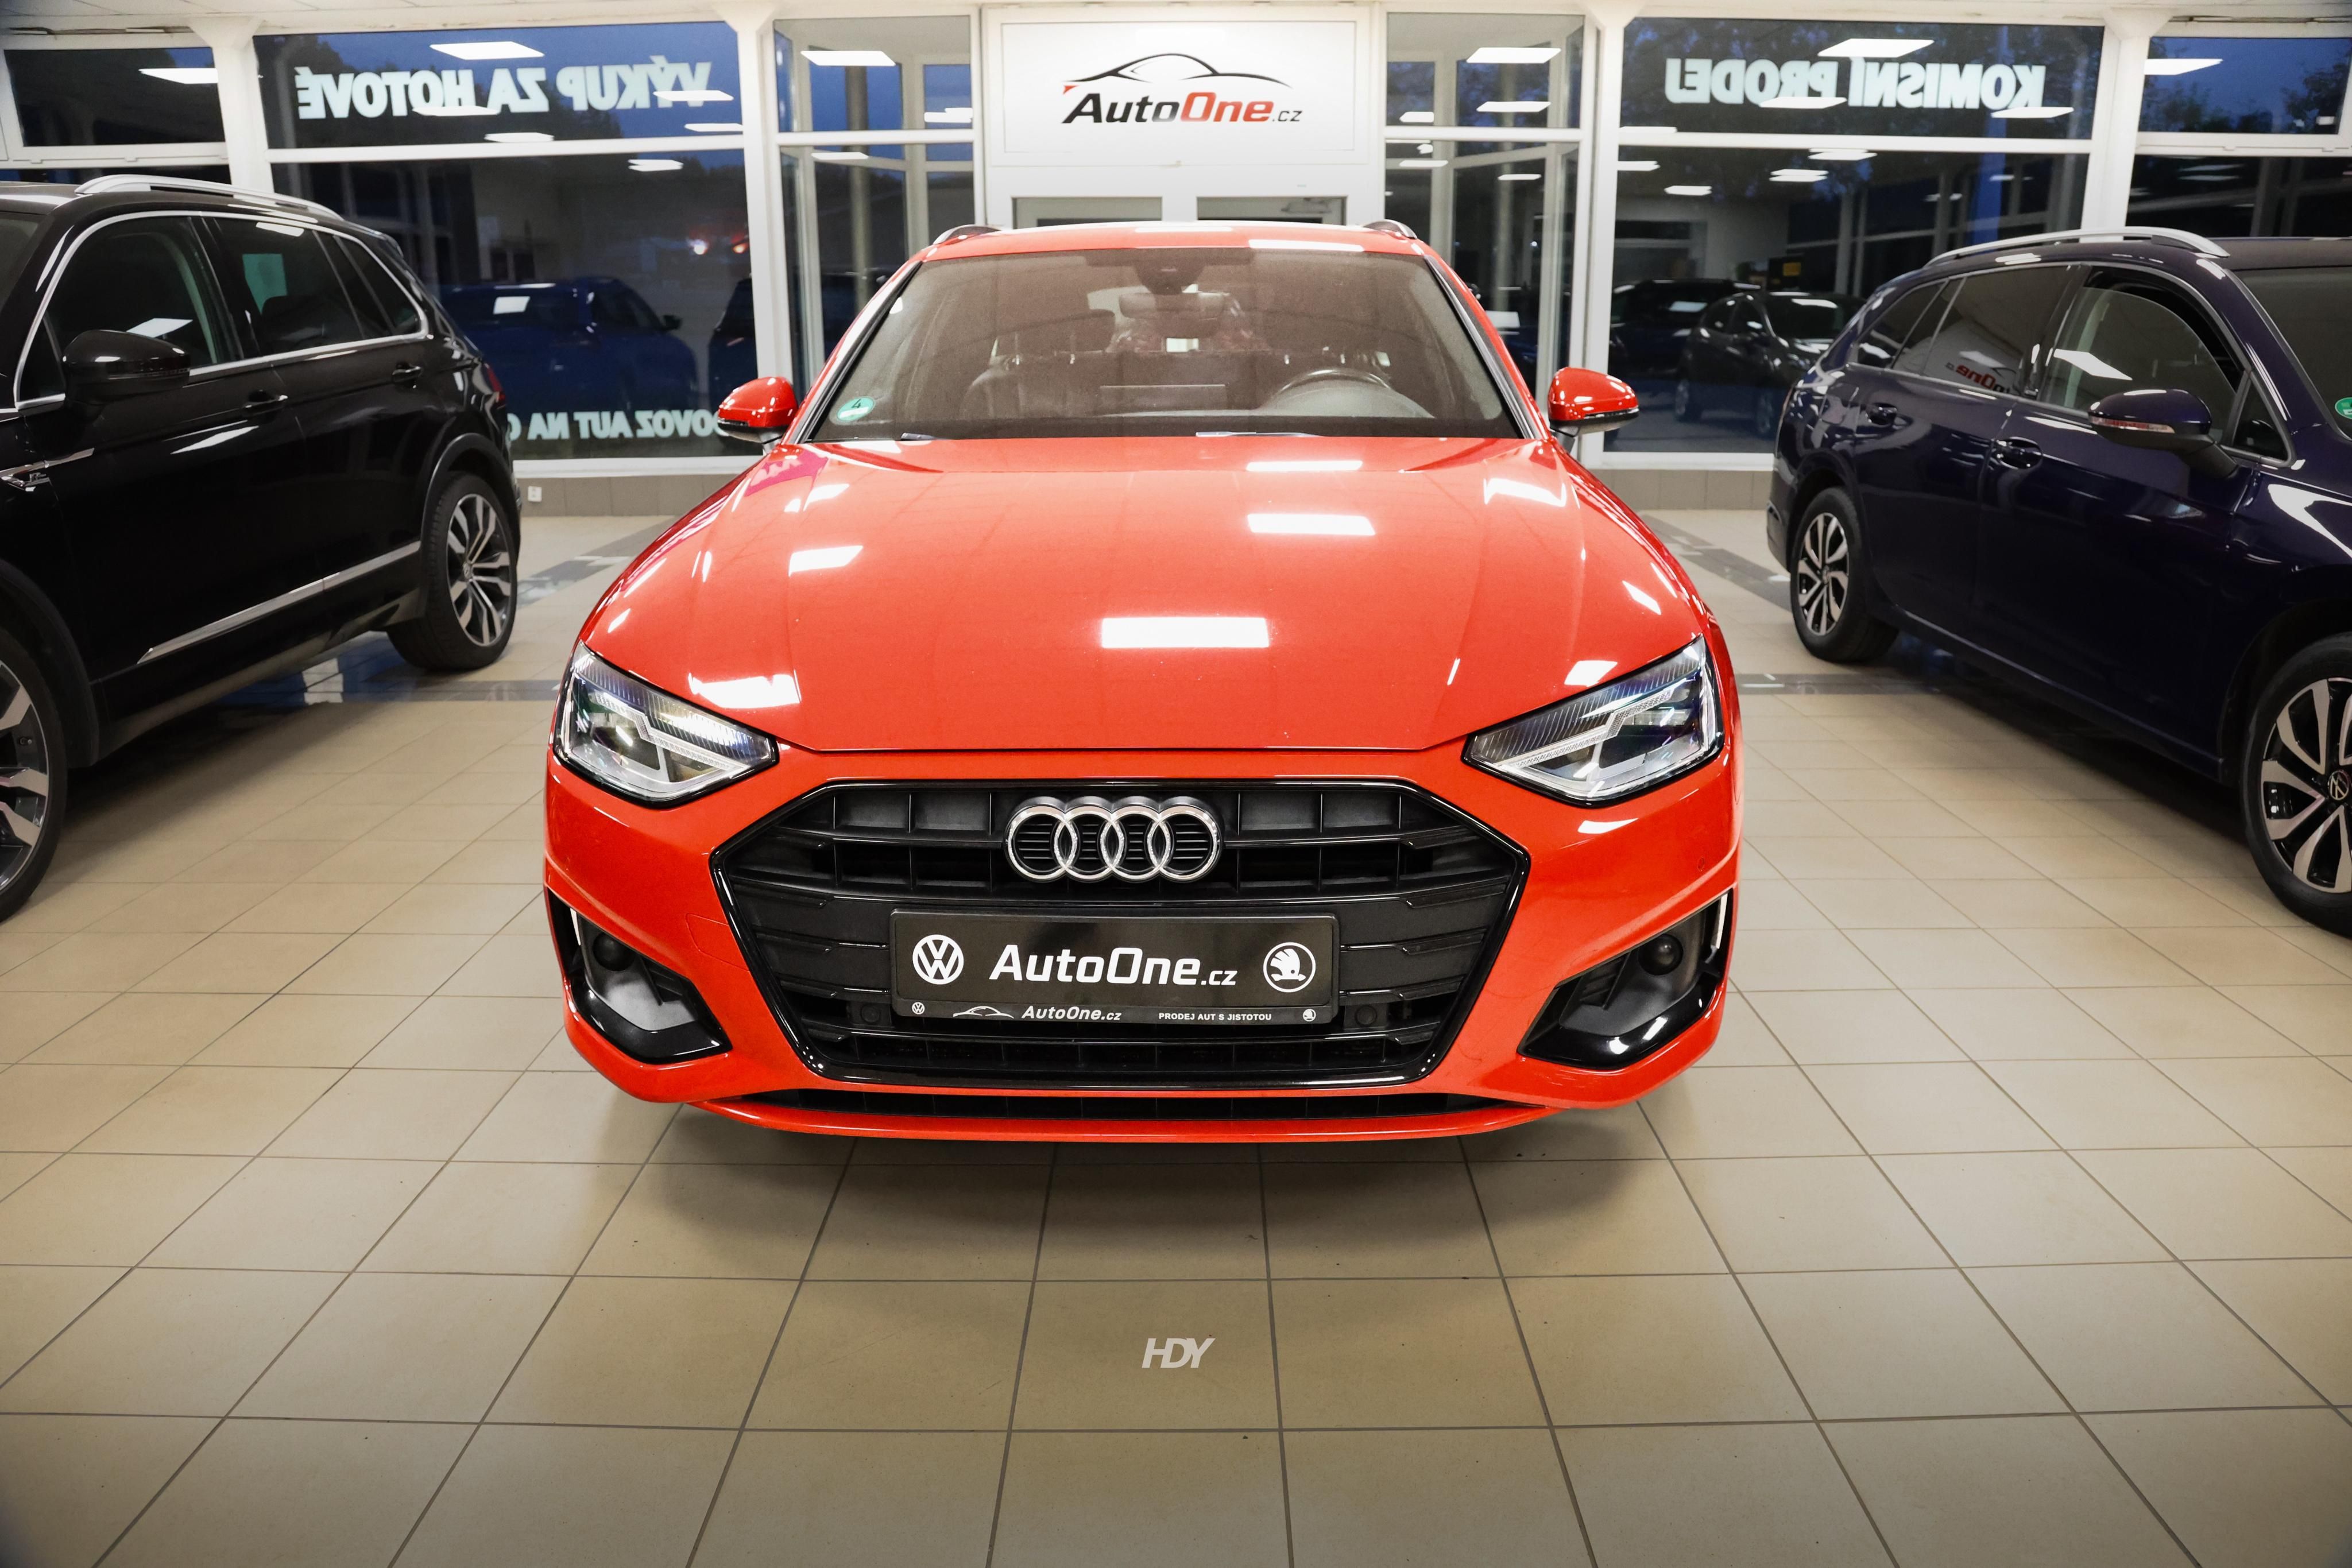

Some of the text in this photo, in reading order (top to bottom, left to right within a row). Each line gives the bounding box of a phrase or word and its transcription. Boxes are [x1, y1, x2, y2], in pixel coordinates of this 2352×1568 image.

[1061, 92, 1302, 123] AutoOne.cz
[989, 944, 1237, 986] AutoOne.cz
[1021, 1005, 1122, 1021] AutoOne.cz
